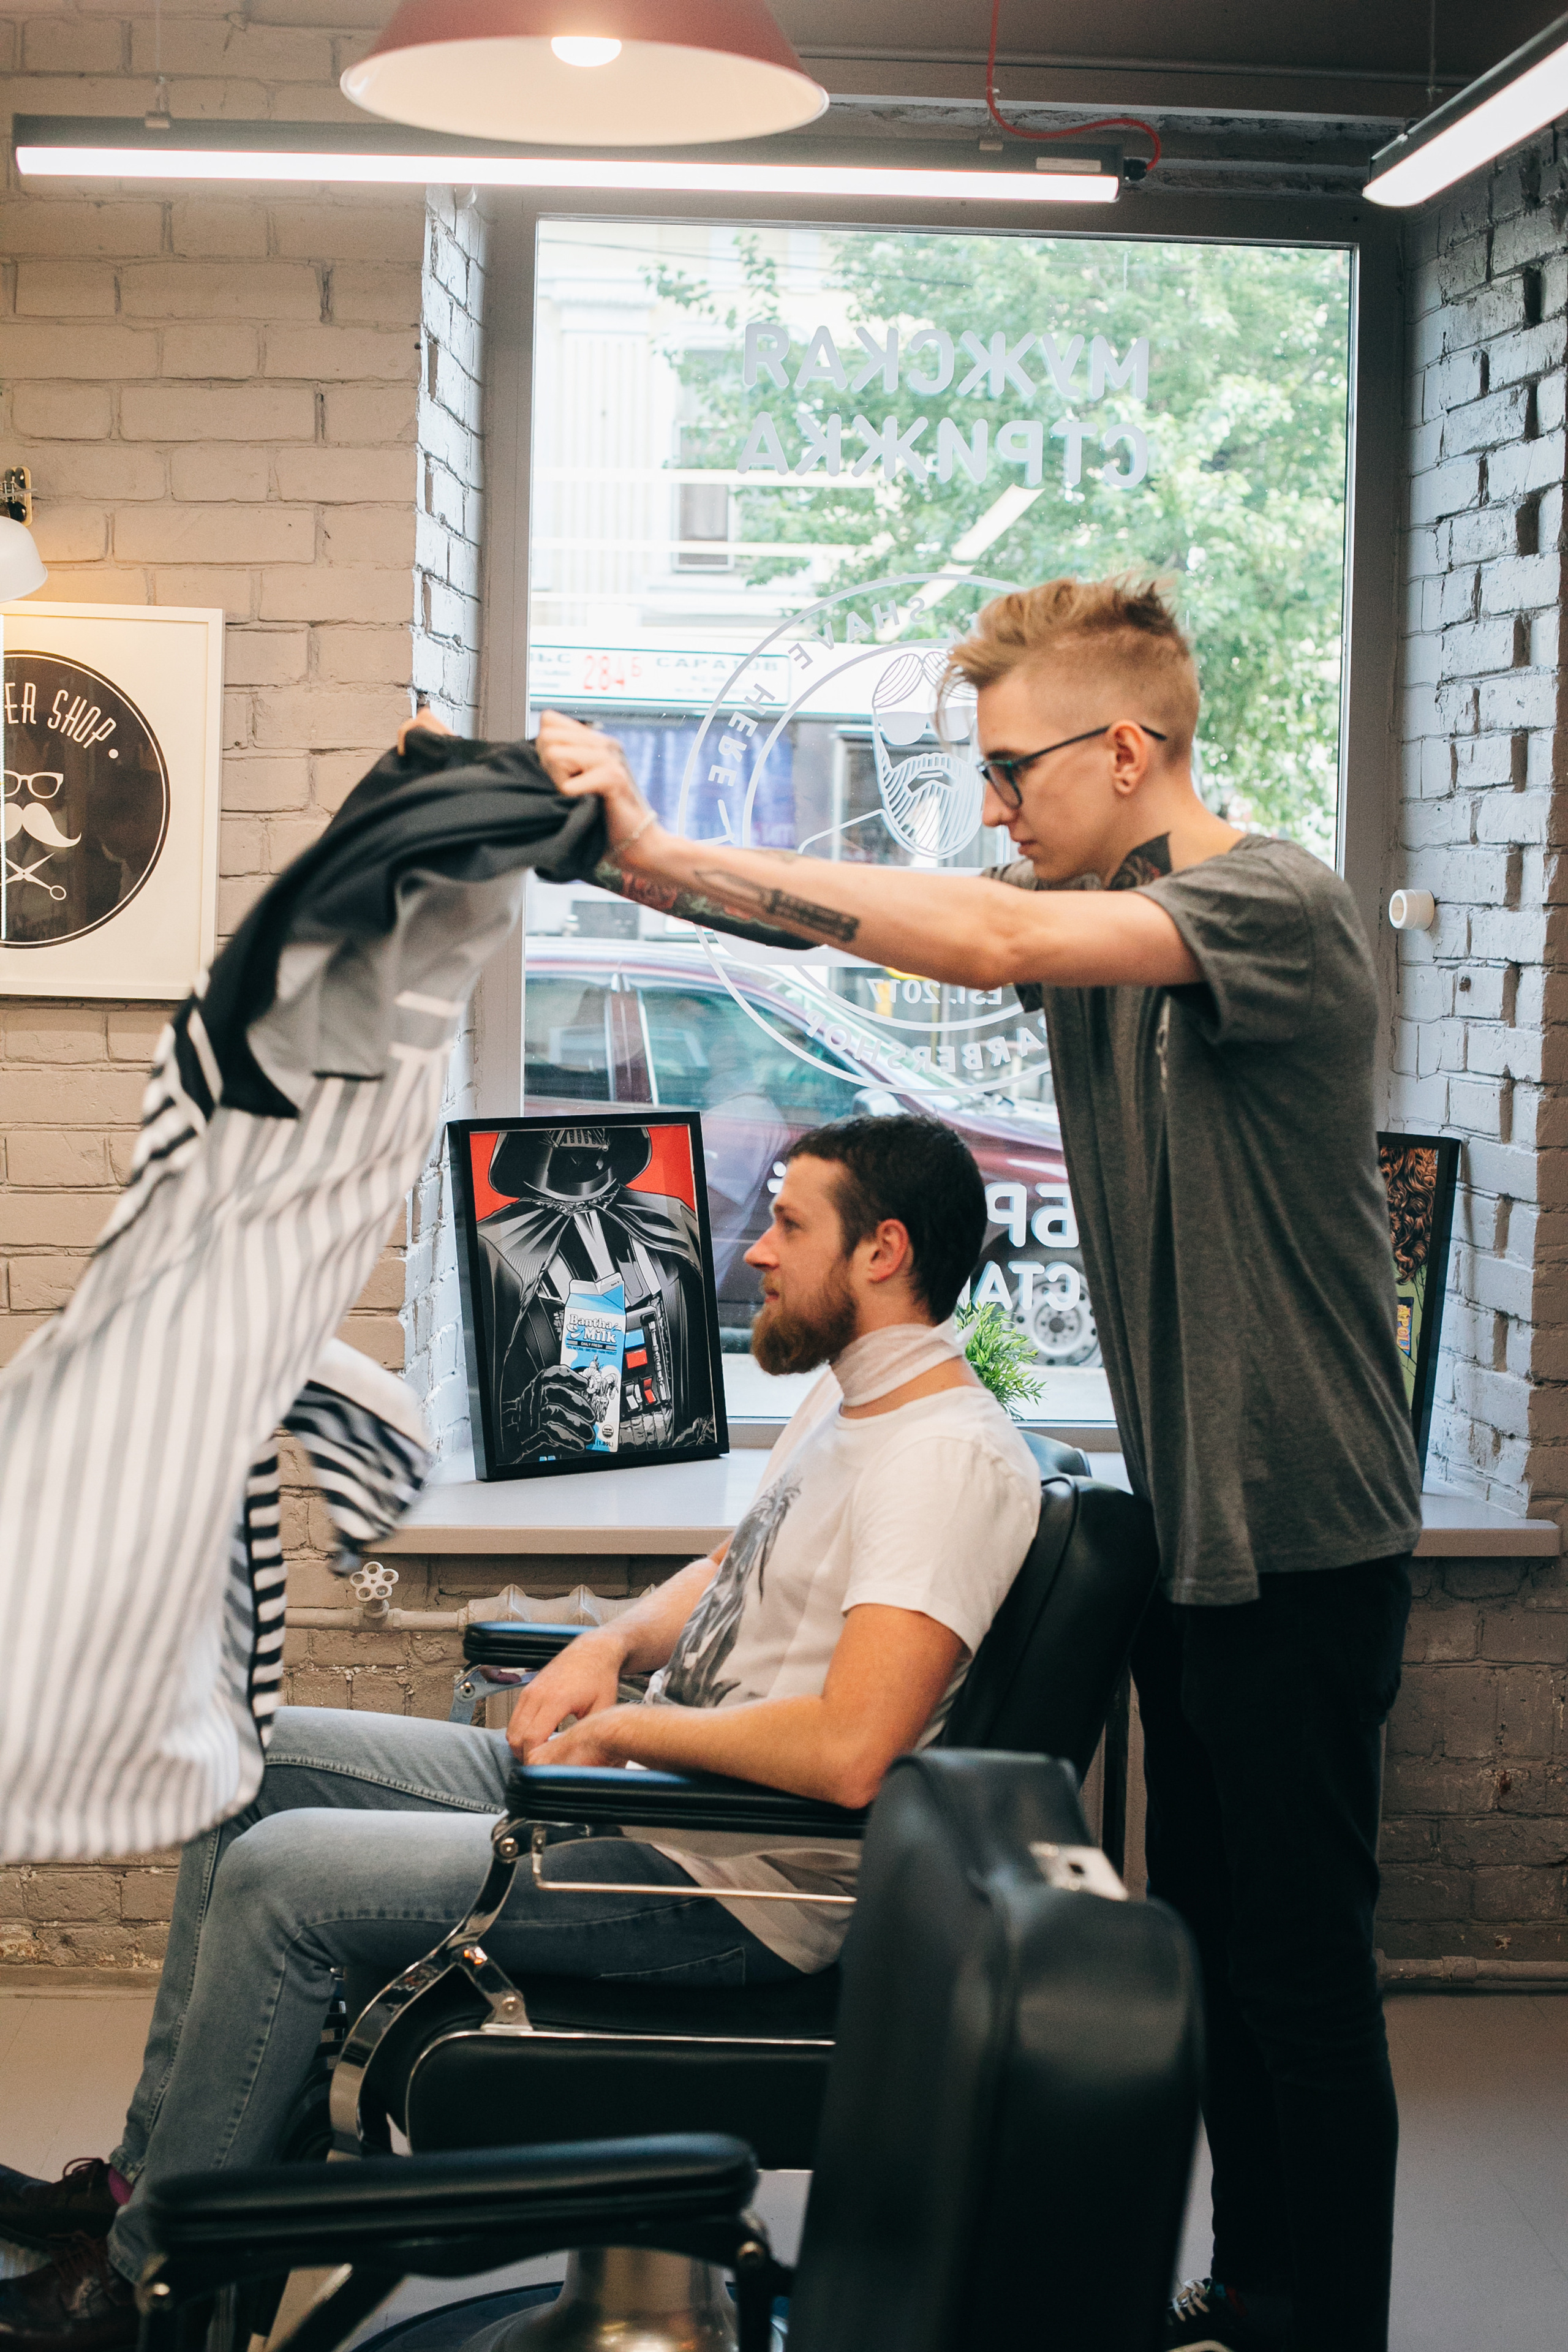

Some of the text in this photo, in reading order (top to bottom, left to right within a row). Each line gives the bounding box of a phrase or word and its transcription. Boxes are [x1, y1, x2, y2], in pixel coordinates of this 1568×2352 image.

[47, 690, 116, 748] SHOP
[570, 1314, 612, 1330] Bantha
[583, 1327, 616, 1343] Milk
